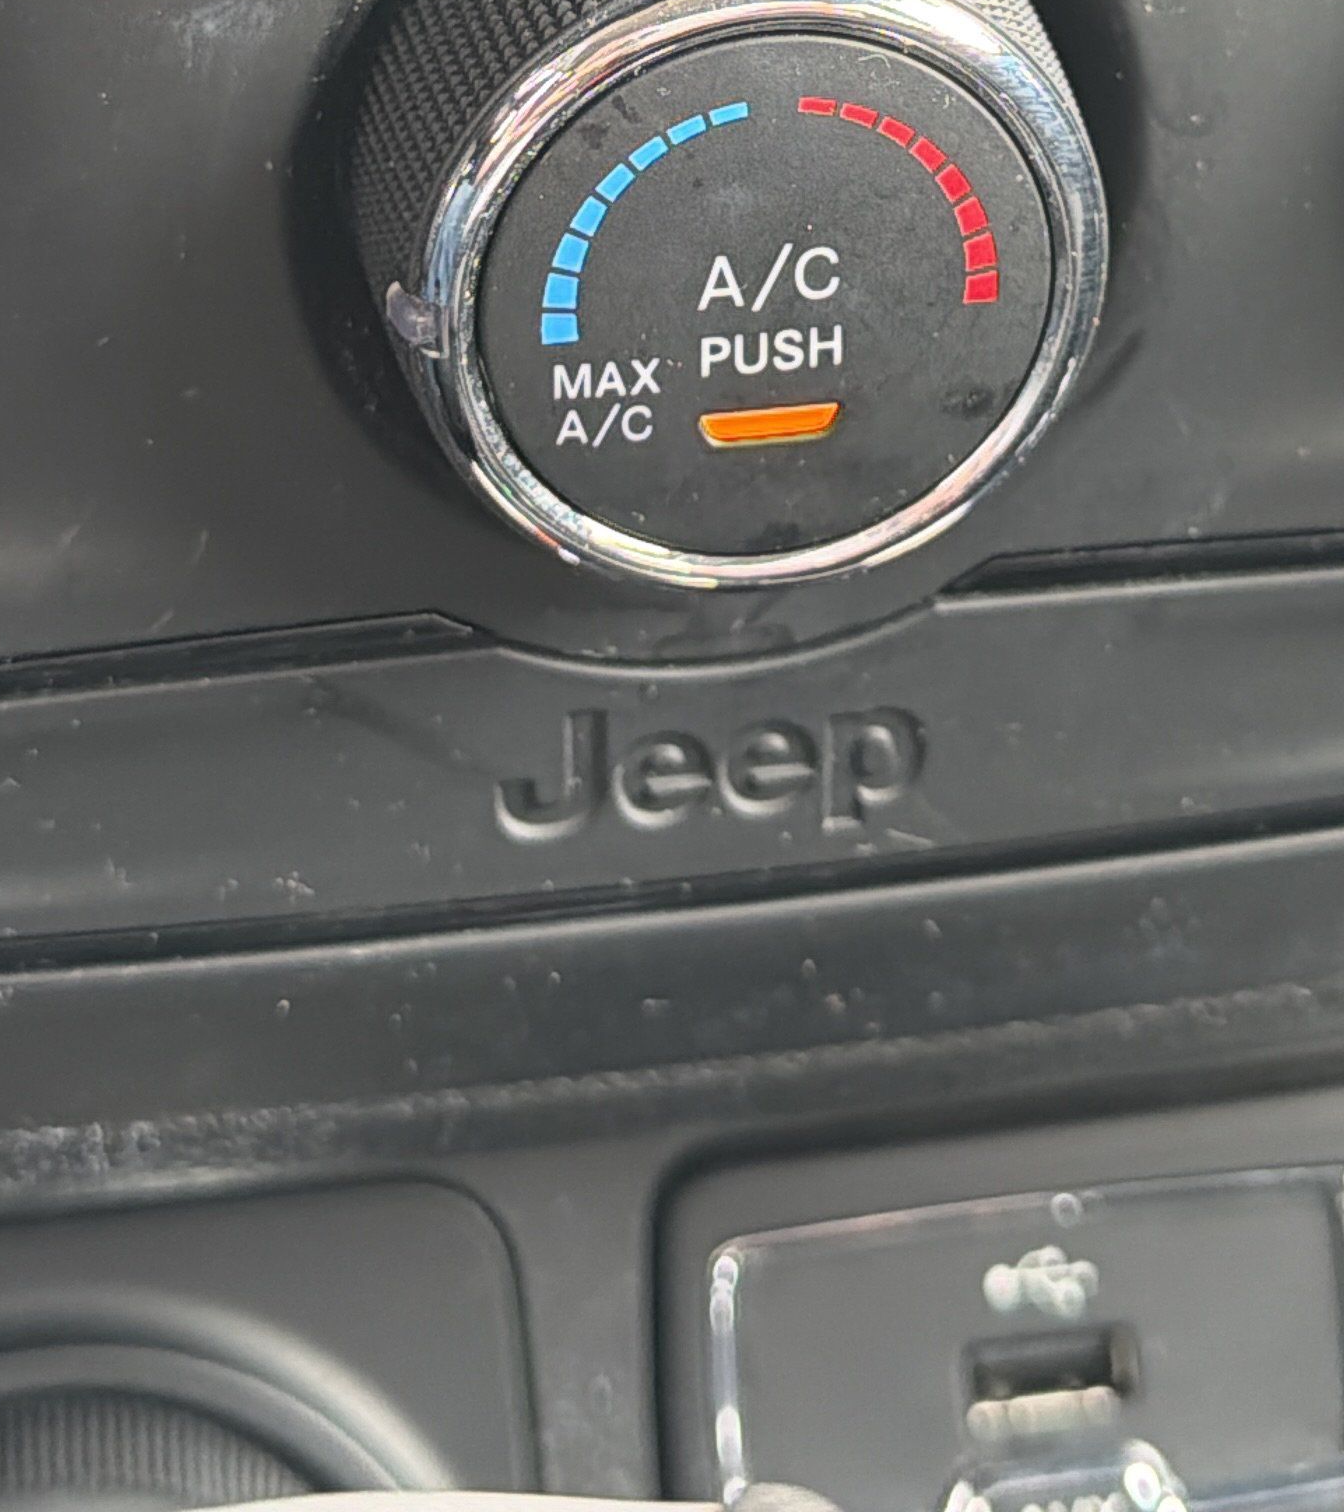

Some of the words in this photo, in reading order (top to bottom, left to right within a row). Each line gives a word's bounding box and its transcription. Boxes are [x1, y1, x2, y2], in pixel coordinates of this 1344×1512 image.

[697, 243, 840, 311] A/C
[701, 325, 843, 377] PUSH
[553, 357, 661, 400] MAX
[556, 403, 654, 448] A/C
[494, 706, 928, 844] Jeep
